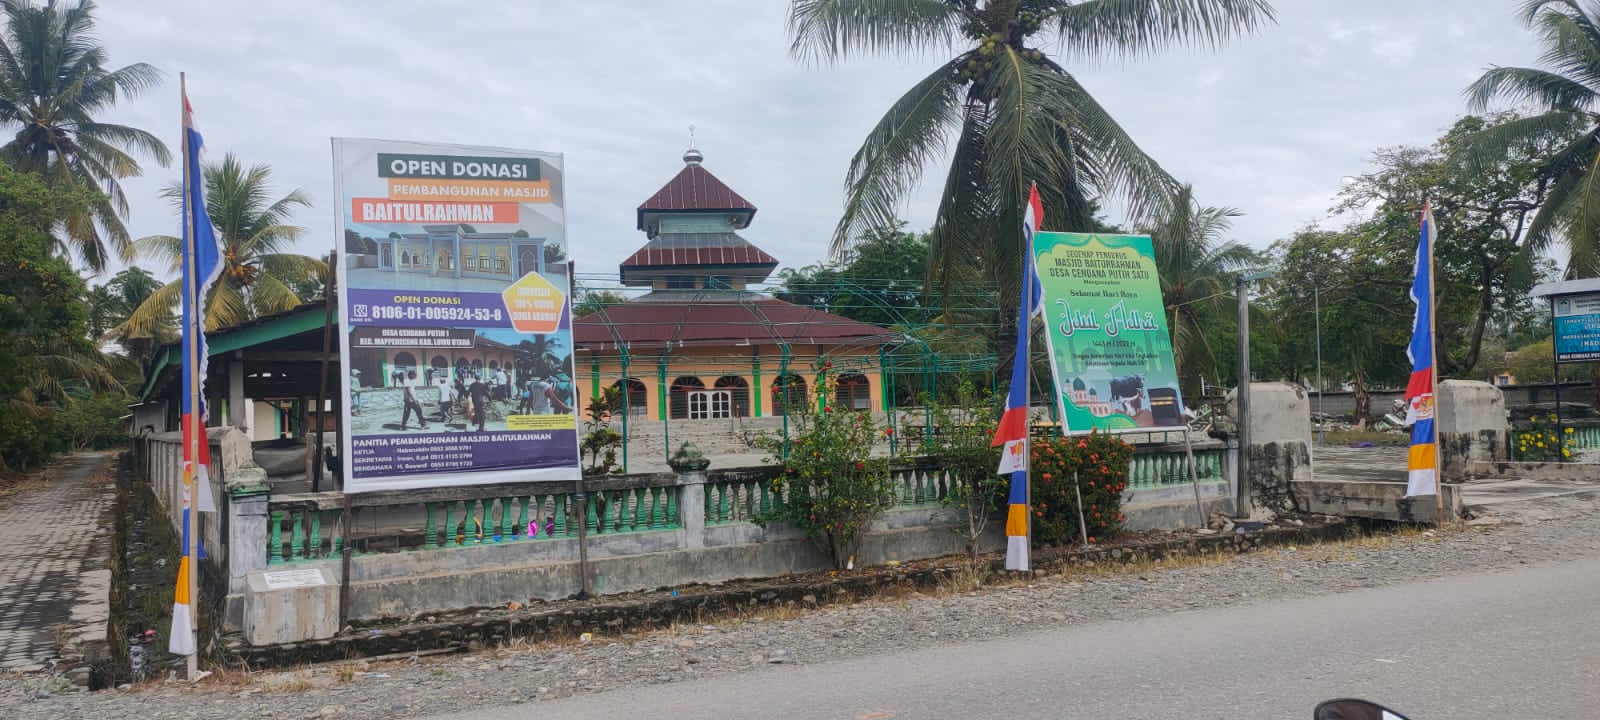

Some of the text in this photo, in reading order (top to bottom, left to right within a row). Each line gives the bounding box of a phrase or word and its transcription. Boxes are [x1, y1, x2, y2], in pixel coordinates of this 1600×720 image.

[390, 159, 528, 179] OPEN DONASI
[393, 184, 549, 198] PEMBANGUNAN MASJID
[362, 202, 494, 222] BAITULRAHMAN
[1054, 258, 1083, 267] MASJID
[1049, 268, 1150, 280] DESA CENDANA PUTIH SATU
[393, 295, 461, 305] OPEN DONASI
[372, 304, 502, 322] 8106-01-005924-53-8
[353, 432, 552, 447] PANITIA PEMBANGUNAN MASJID BAITULRAHMAN
